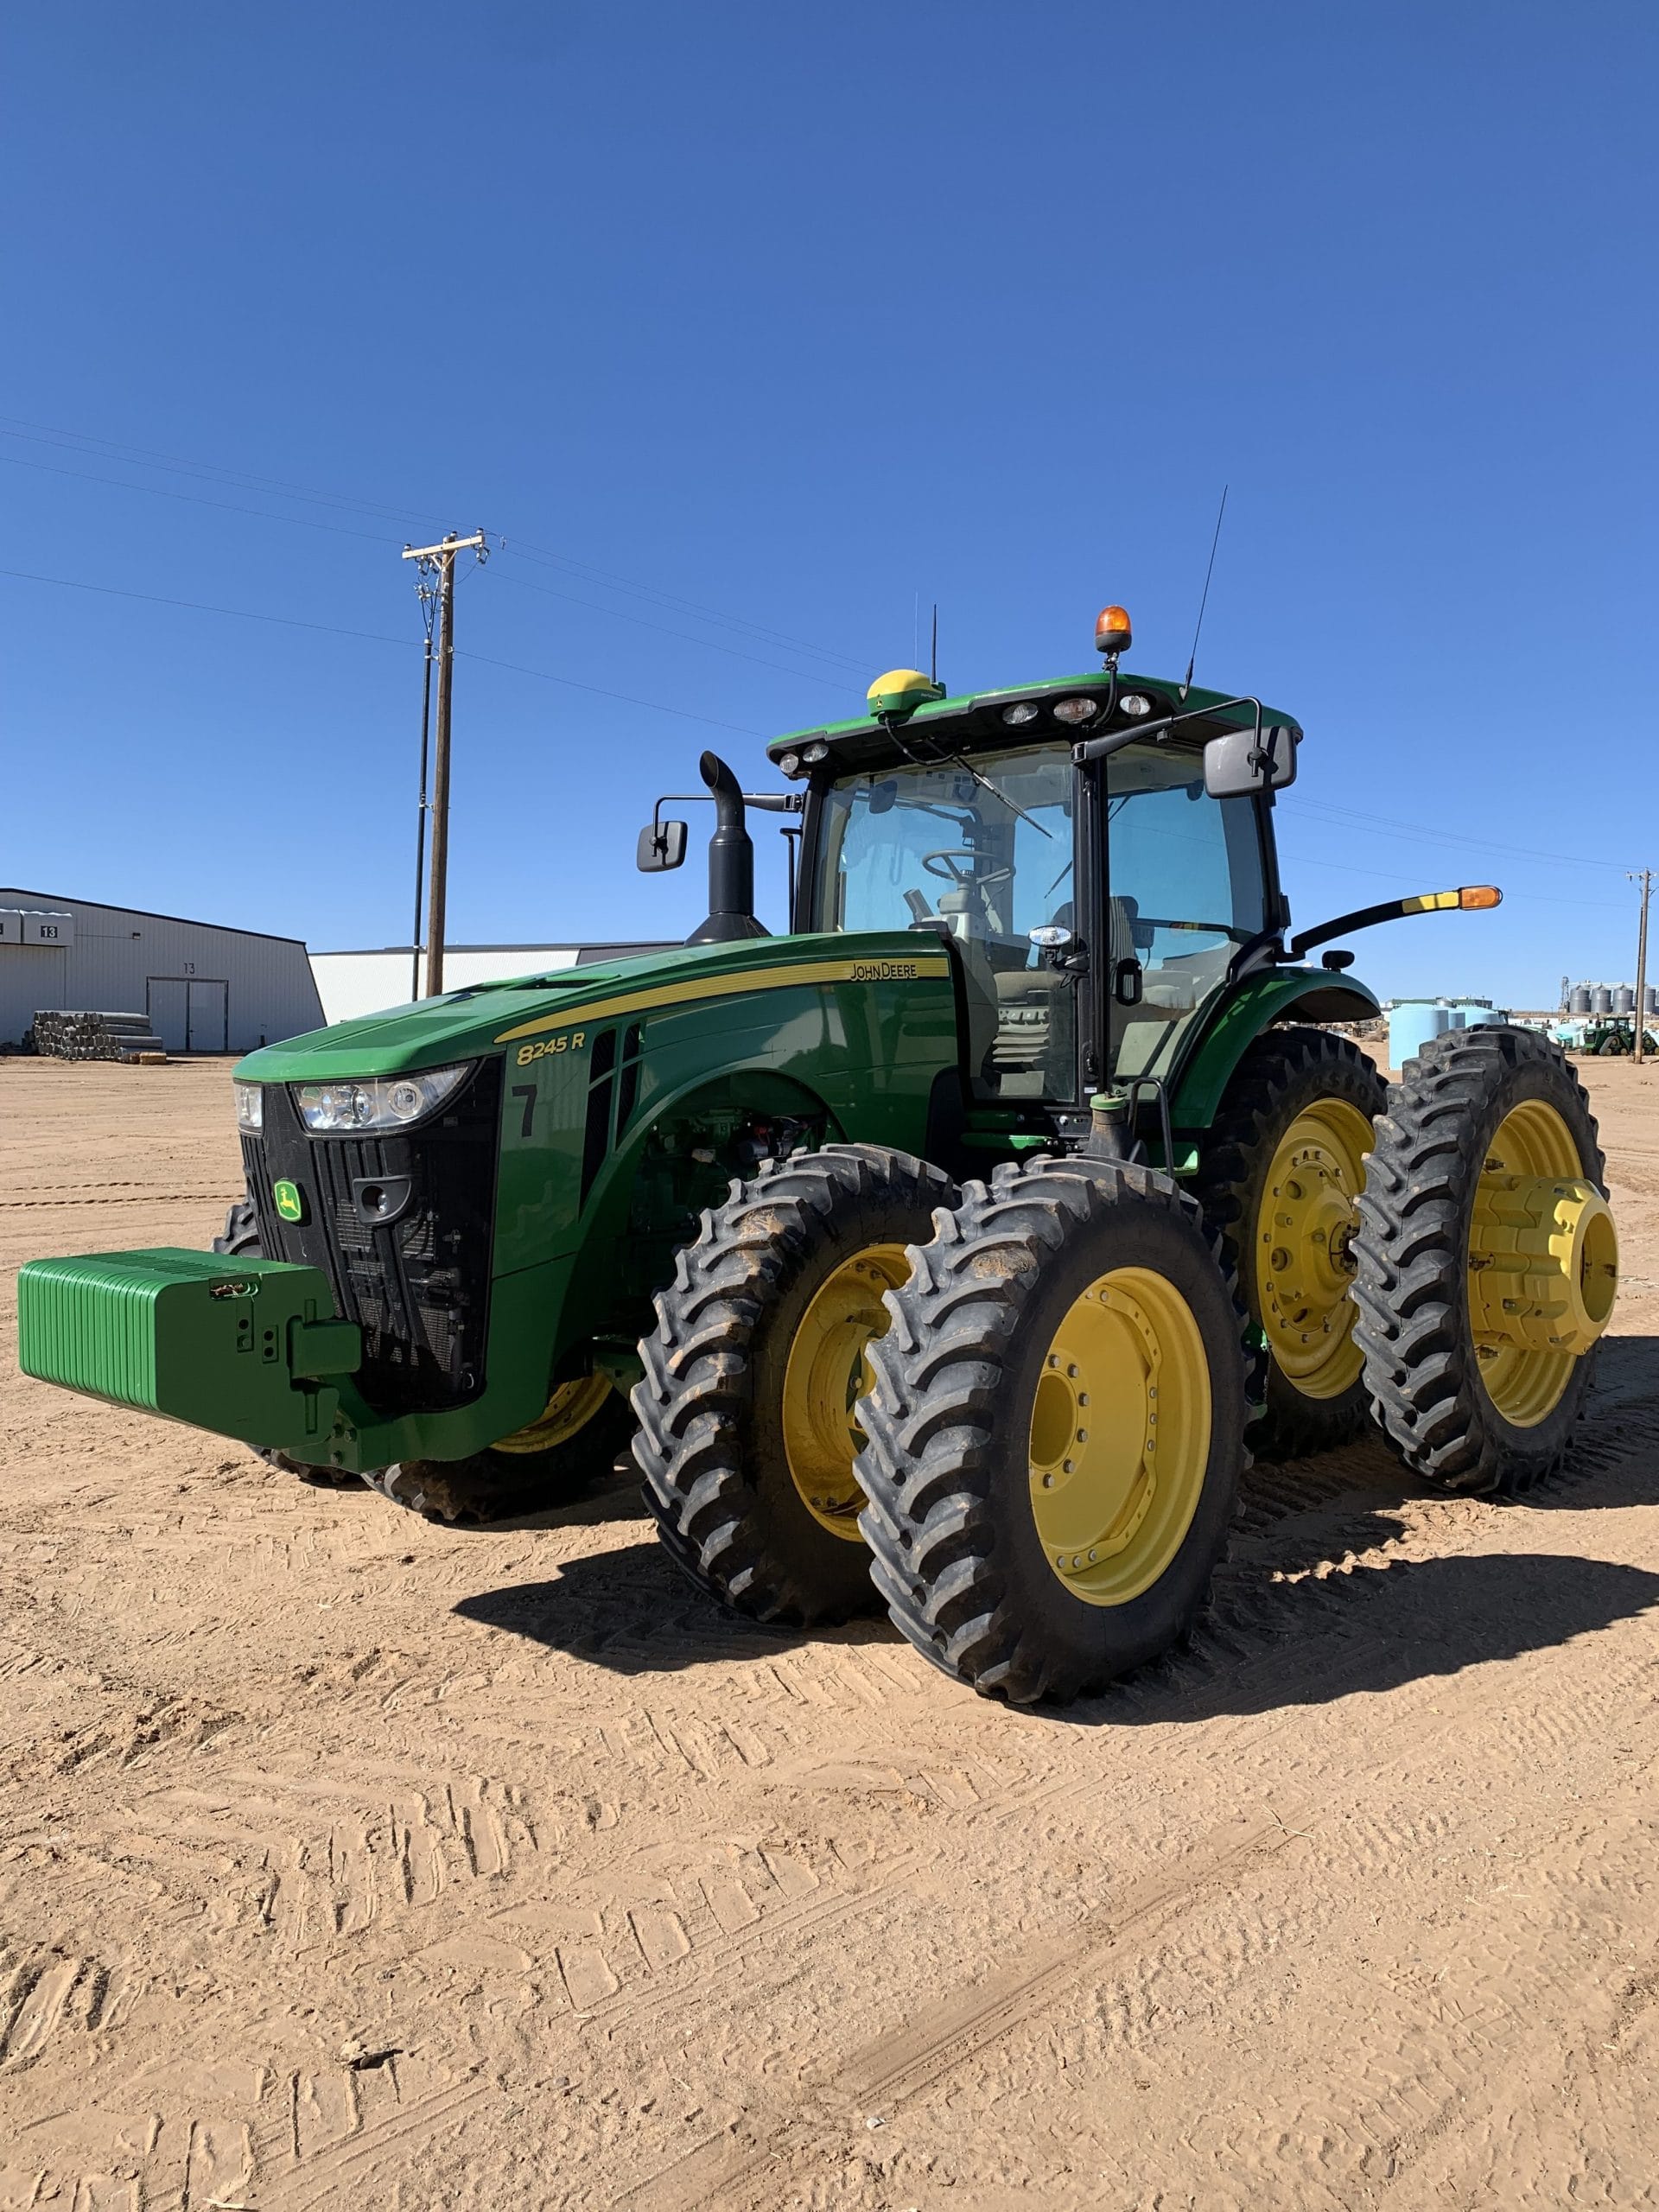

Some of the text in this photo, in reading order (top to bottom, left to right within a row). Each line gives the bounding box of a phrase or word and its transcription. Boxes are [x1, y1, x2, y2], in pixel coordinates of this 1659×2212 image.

[42, 927, 56, 938] 13
[184, 963, 195, 974] 13
[850, 962, 918, 981] JOHN DEERE
[517, 1032, 585, 1066] 8245 R
[512, 1084, 537, 1138] 7
